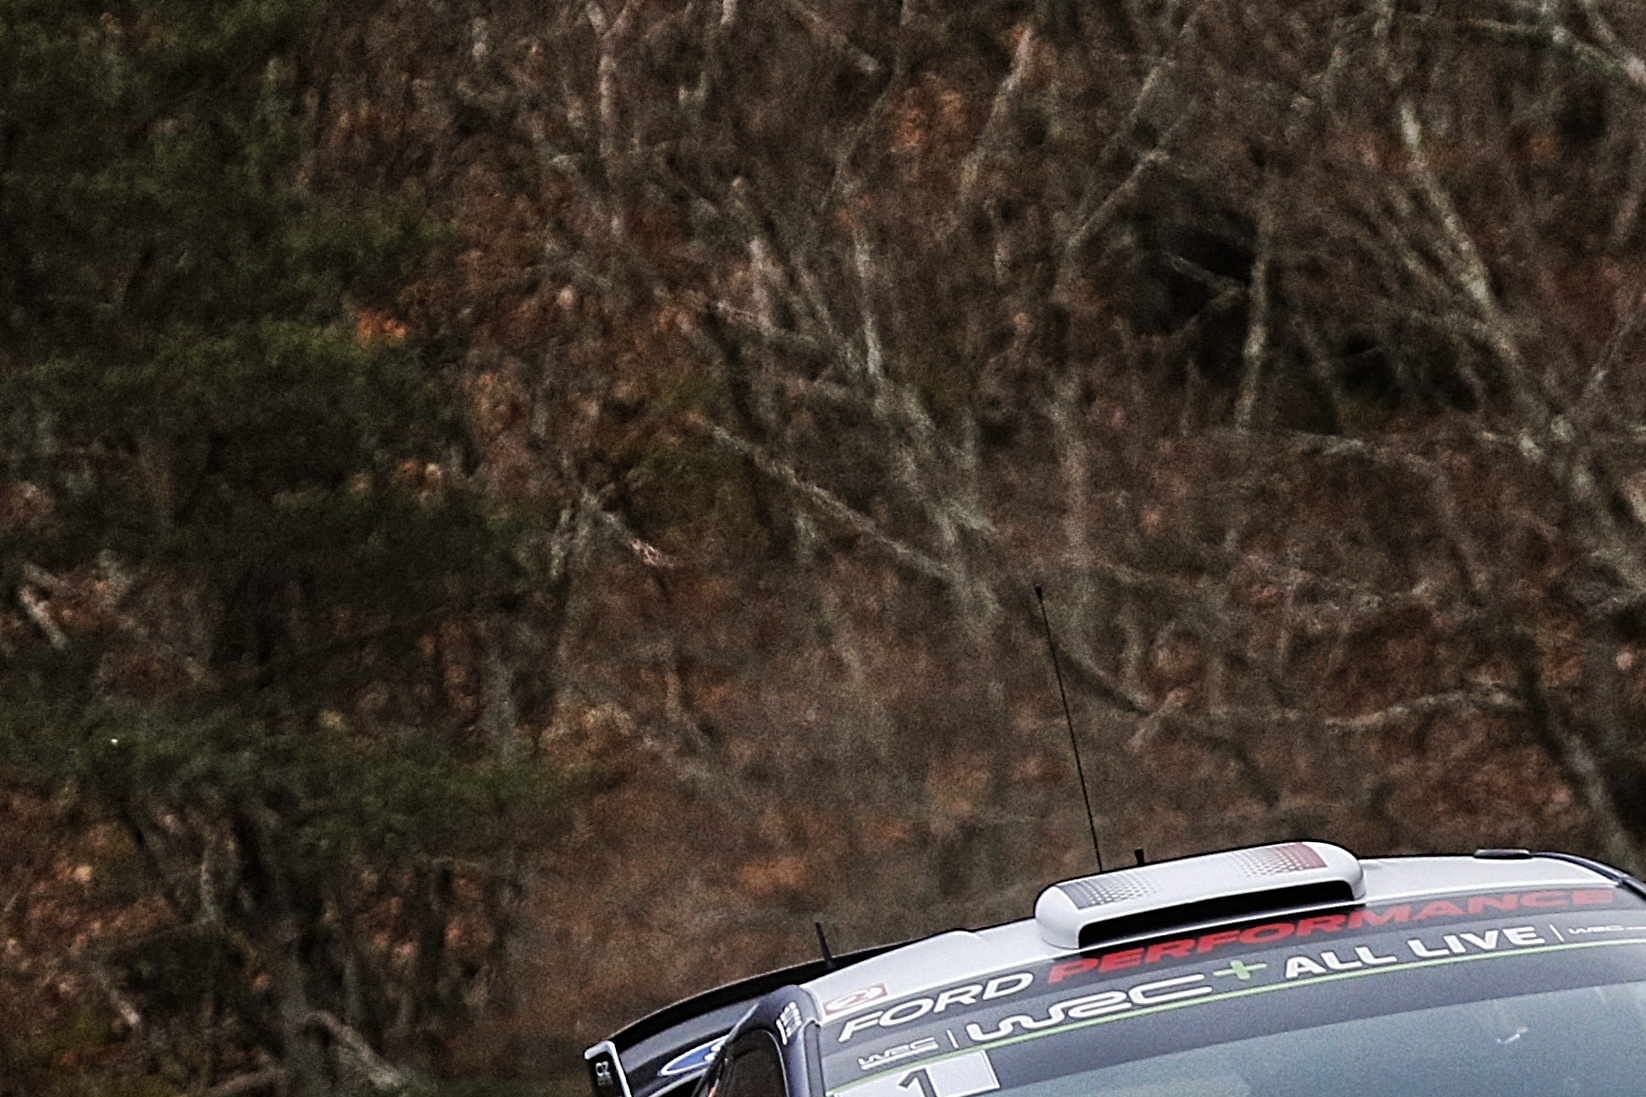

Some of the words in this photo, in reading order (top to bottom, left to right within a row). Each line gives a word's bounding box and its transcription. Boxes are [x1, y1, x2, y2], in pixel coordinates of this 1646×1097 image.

[838, 972, 1035, 1043] FORD
[1047, 889, 1614, 984] PERFORMANCE
[1284, 945, 1397, 979] ALL
[1407, 925, 1545, 958] LIVE
